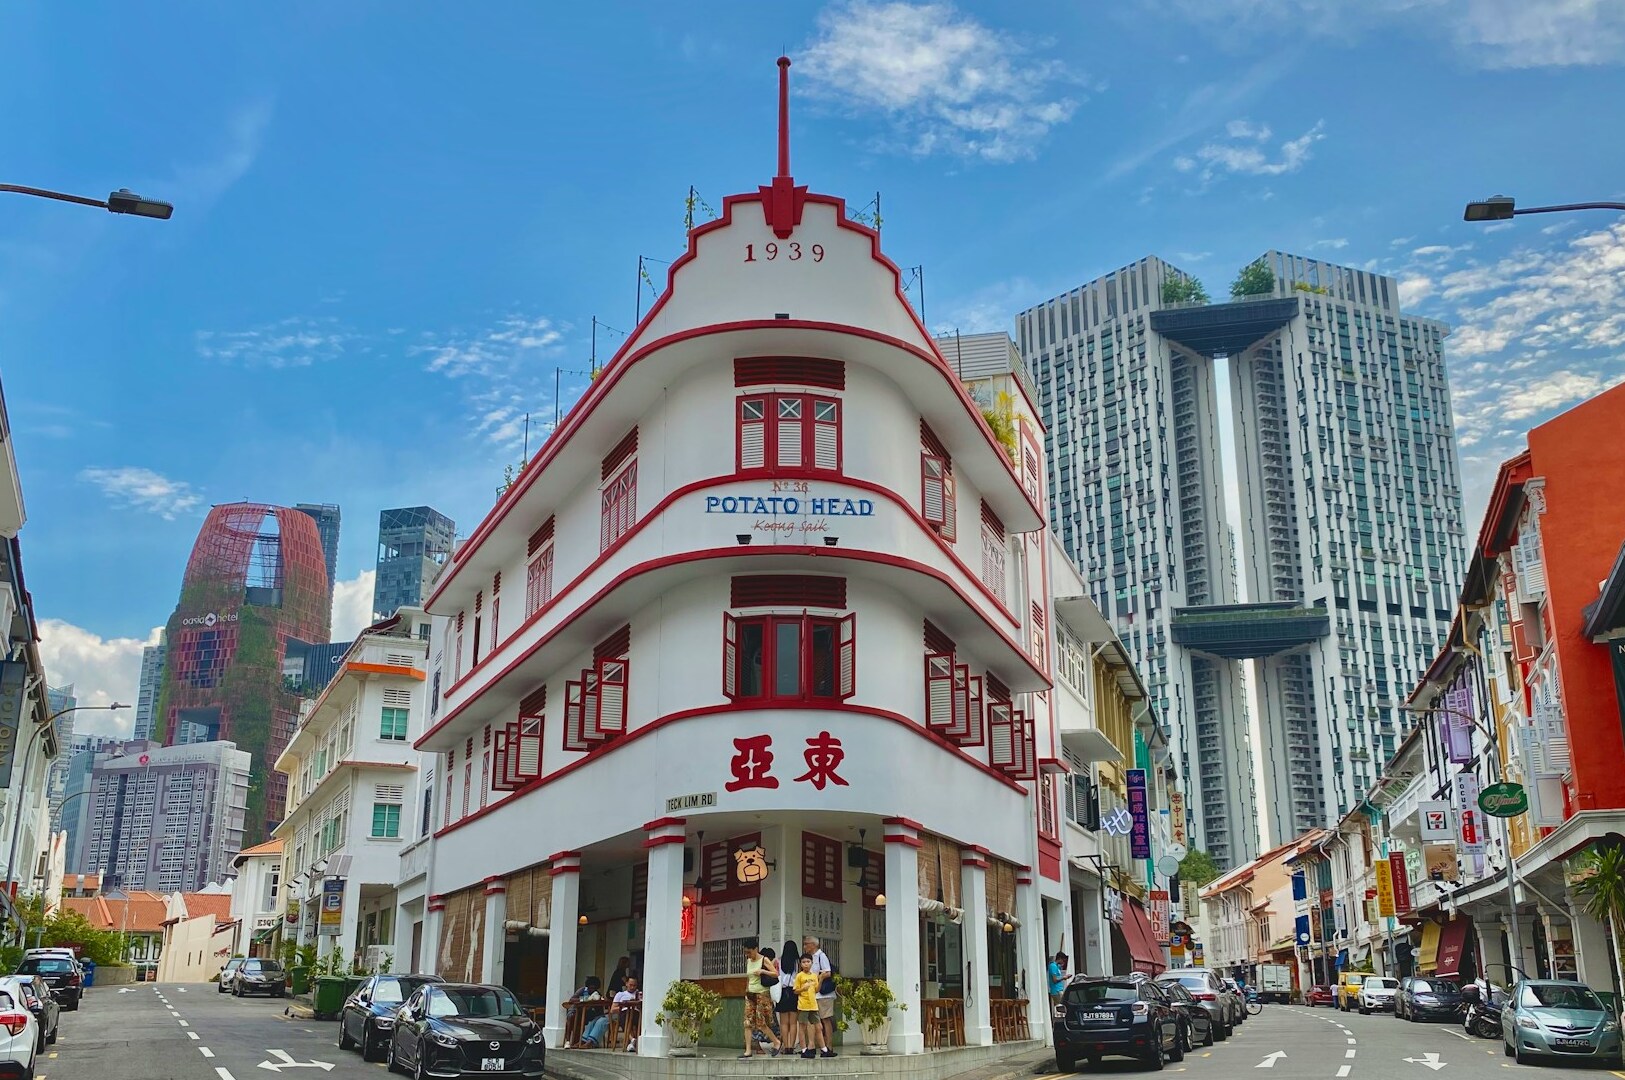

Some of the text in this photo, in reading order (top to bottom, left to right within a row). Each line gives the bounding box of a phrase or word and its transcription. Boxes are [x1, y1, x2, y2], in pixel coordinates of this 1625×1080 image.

[744, 242, 825, 263] 1939
[793, 481, 808, 492] 36
[705, 496, 874, 516] POTATO HEAD
[753, 519, 795, 538] Keong
[182, 611, 239, 626] oasia hotel
[667, 793, 714, 812] TECK LIM RD
[1458, 776, 1467, 810] FOCUS
[1429, 813, 1442, 821] 7
[1462, 812, 1472, 843] MUSIC
